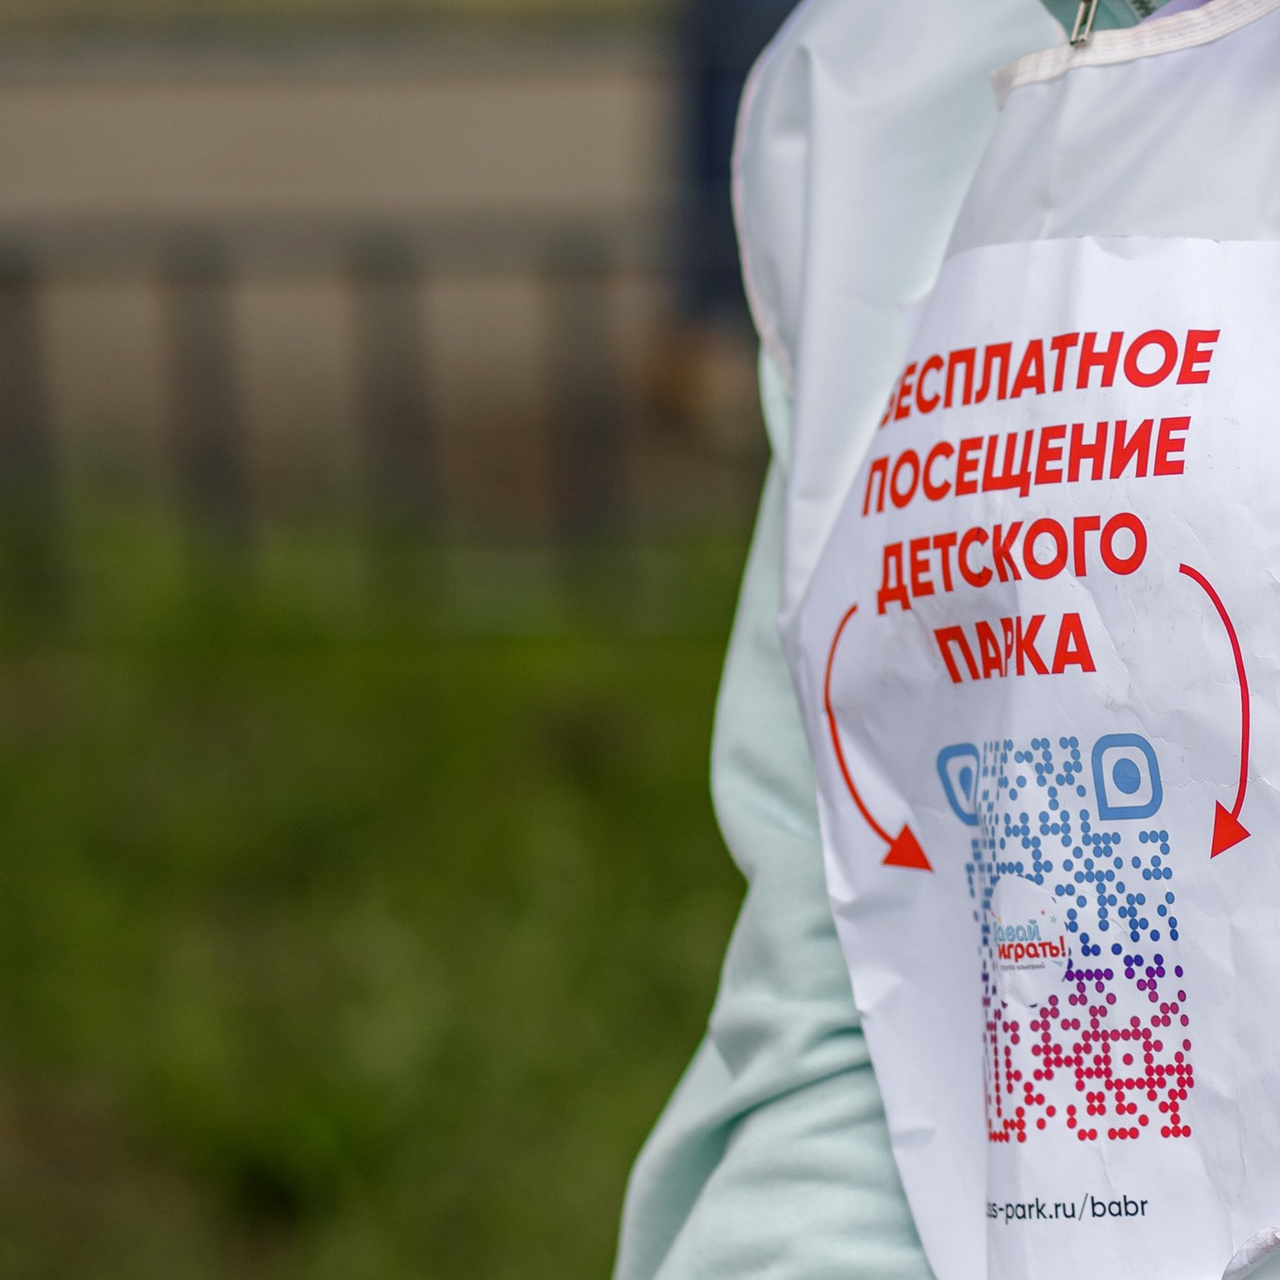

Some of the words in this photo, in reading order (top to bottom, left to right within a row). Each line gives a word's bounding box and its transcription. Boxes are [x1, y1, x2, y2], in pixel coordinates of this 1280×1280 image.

[863, 416, 1191, 516] ПОСЕЩЕНИЕ
[876, 512, 1148, 616] ДЕТСКОГО
[934, 612, 1096, 684] ПАРКА
[998, 935, 1067, 962] играть!
